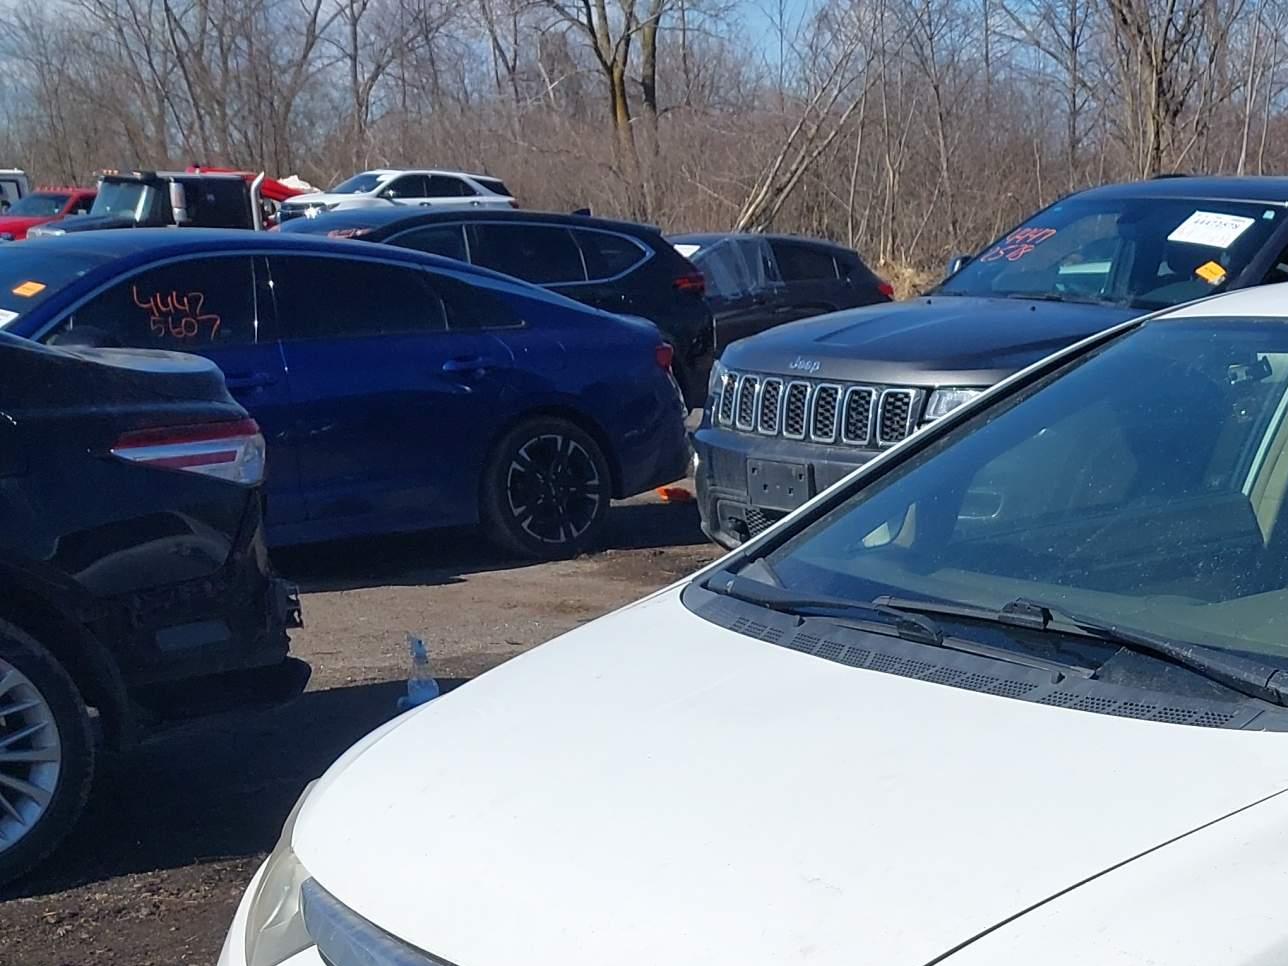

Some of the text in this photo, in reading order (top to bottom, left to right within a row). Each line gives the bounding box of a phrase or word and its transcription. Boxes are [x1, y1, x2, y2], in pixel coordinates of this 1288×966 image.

[132, 285, 204, 317] 4447
[150, 314, 221, 341] 5607
[789, 355, 821, 374] Jeep
